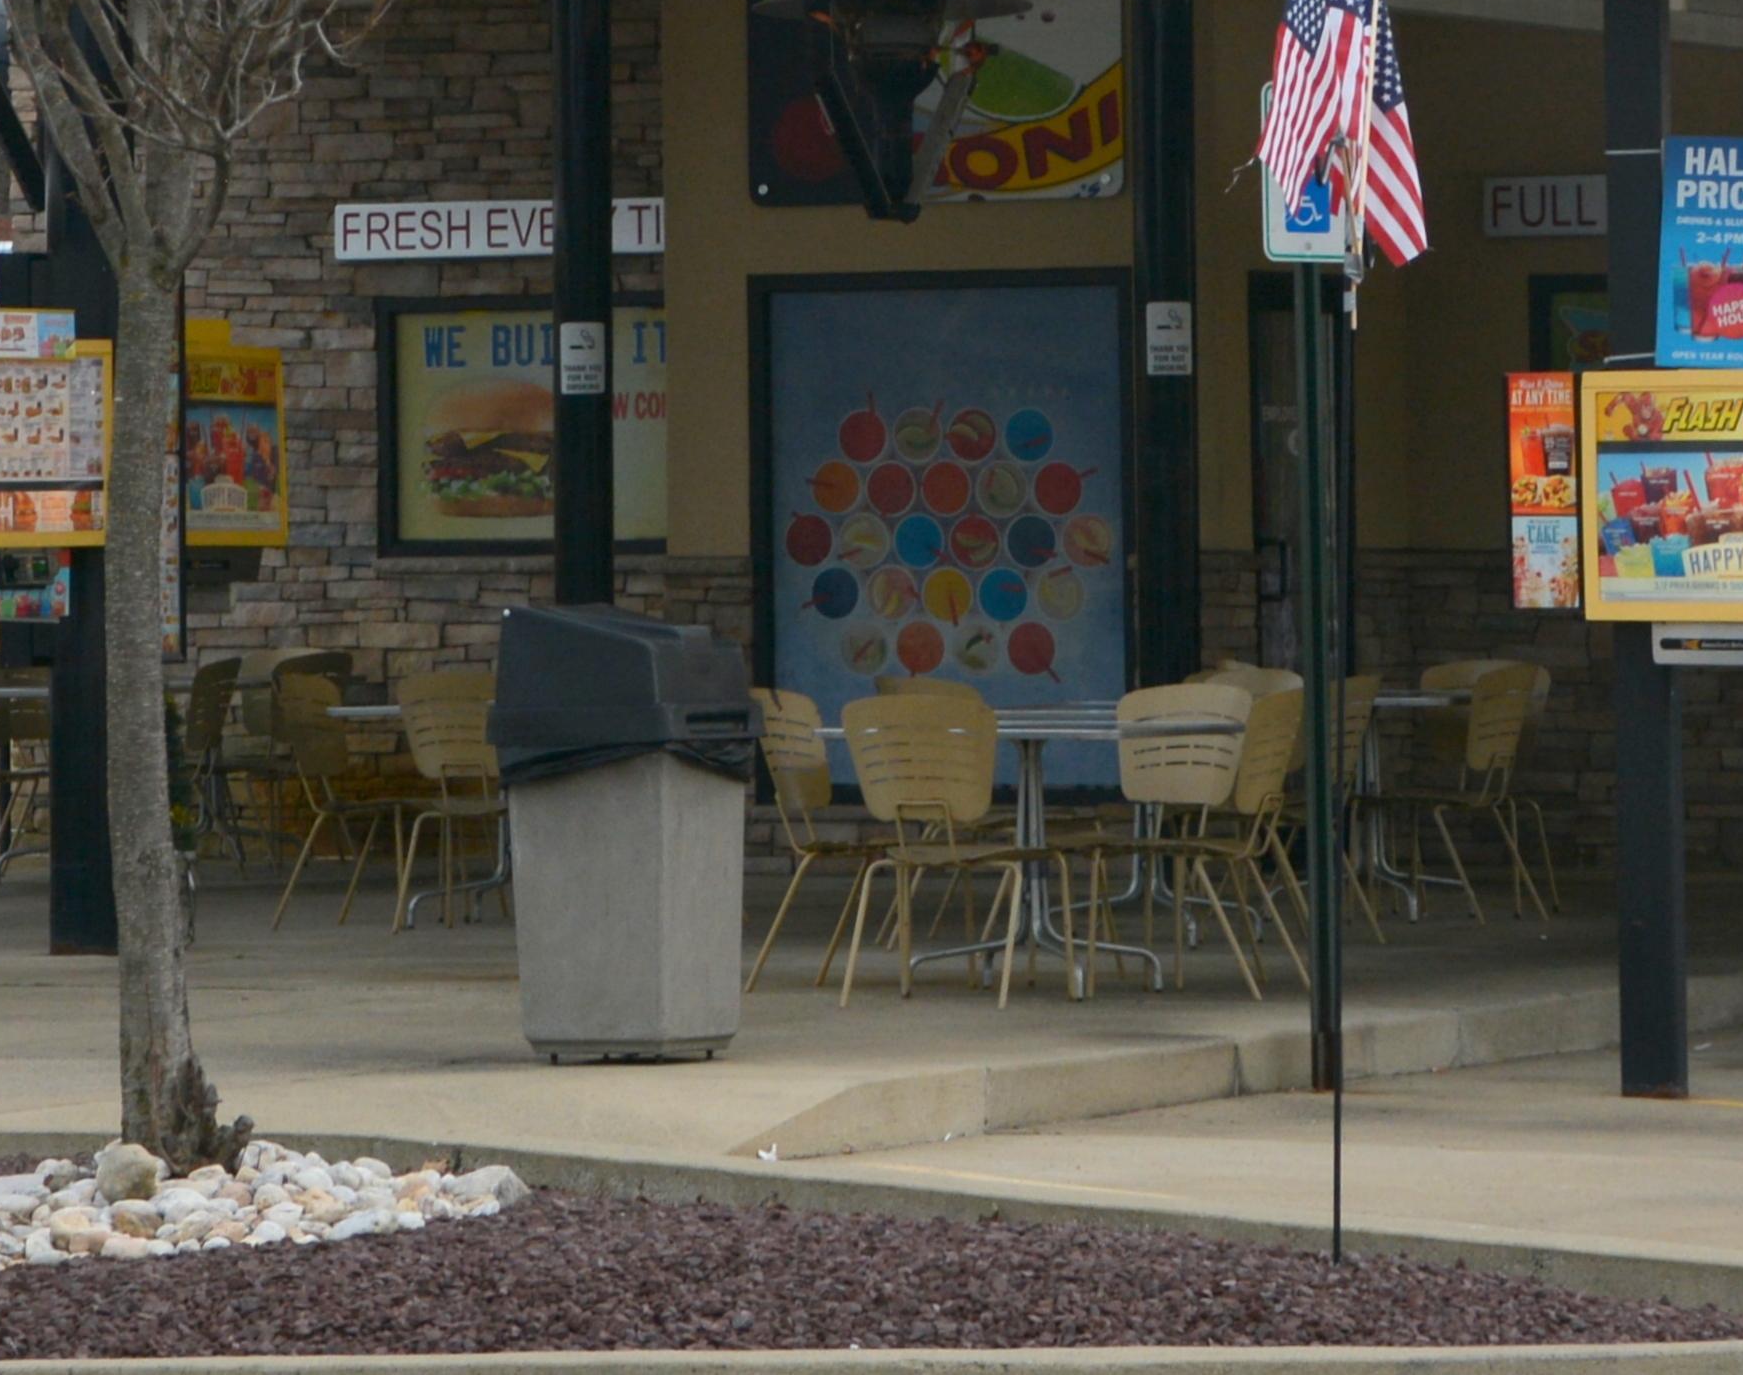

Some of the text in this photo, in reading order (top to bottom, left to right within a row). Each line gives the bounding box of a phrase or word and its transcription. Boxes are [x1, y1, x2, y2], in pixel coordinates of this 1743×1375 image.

[930, 89, 1121, 190] ONI
[342, 209, 472, 251] FRESH
[627, 204, 661, 245] TI
[1490, 184, 1598, 228] FULL
[1676, 215, 1713, 227] DRINKS
[424, 325, 467, 368] WE
[490, 324, 554, 367] BUI
[1672, 350, 1697, 360] OPEN
[1699, 351, 1725, 361] YEAR
[1688, 549, 1743, 575] HAPPY
